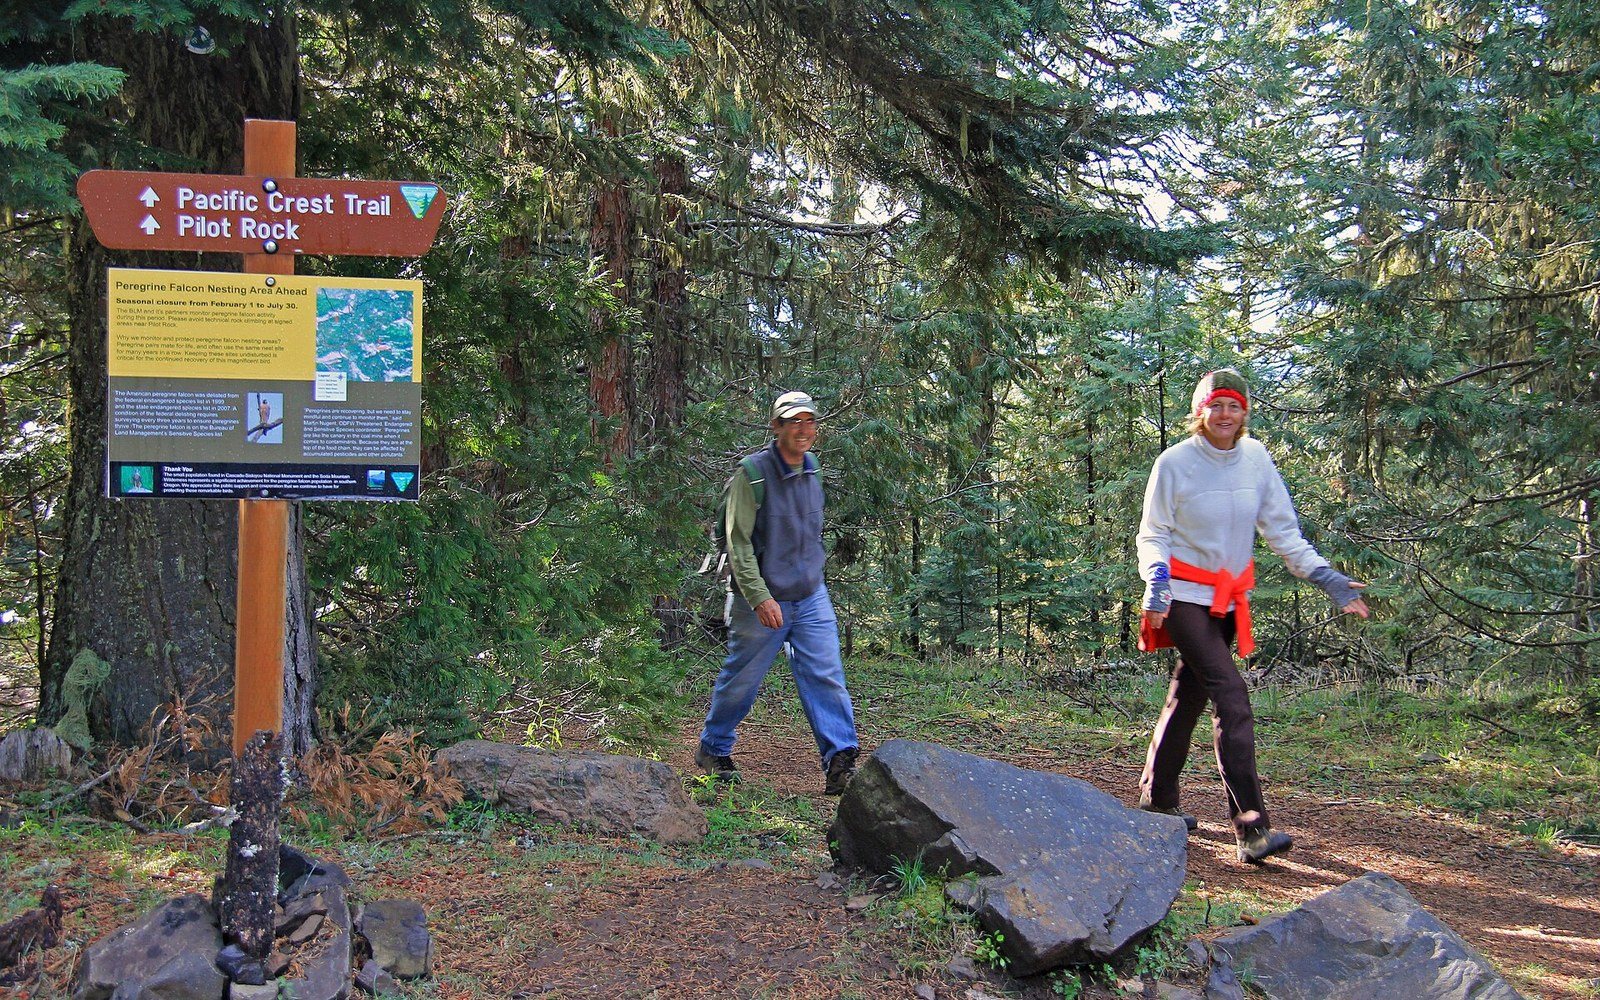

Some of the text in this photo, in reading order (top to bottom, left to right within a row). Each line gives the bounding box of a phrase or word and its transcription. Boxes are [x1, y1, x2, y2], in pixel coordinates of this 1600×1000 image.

[178, 187, 390, 216] Pacific Crest Trail
[178, 215, 300, 240] Pilot Rock
[116, 282, 307, 295] Peregrine Falcon Nesting Area Ahead
